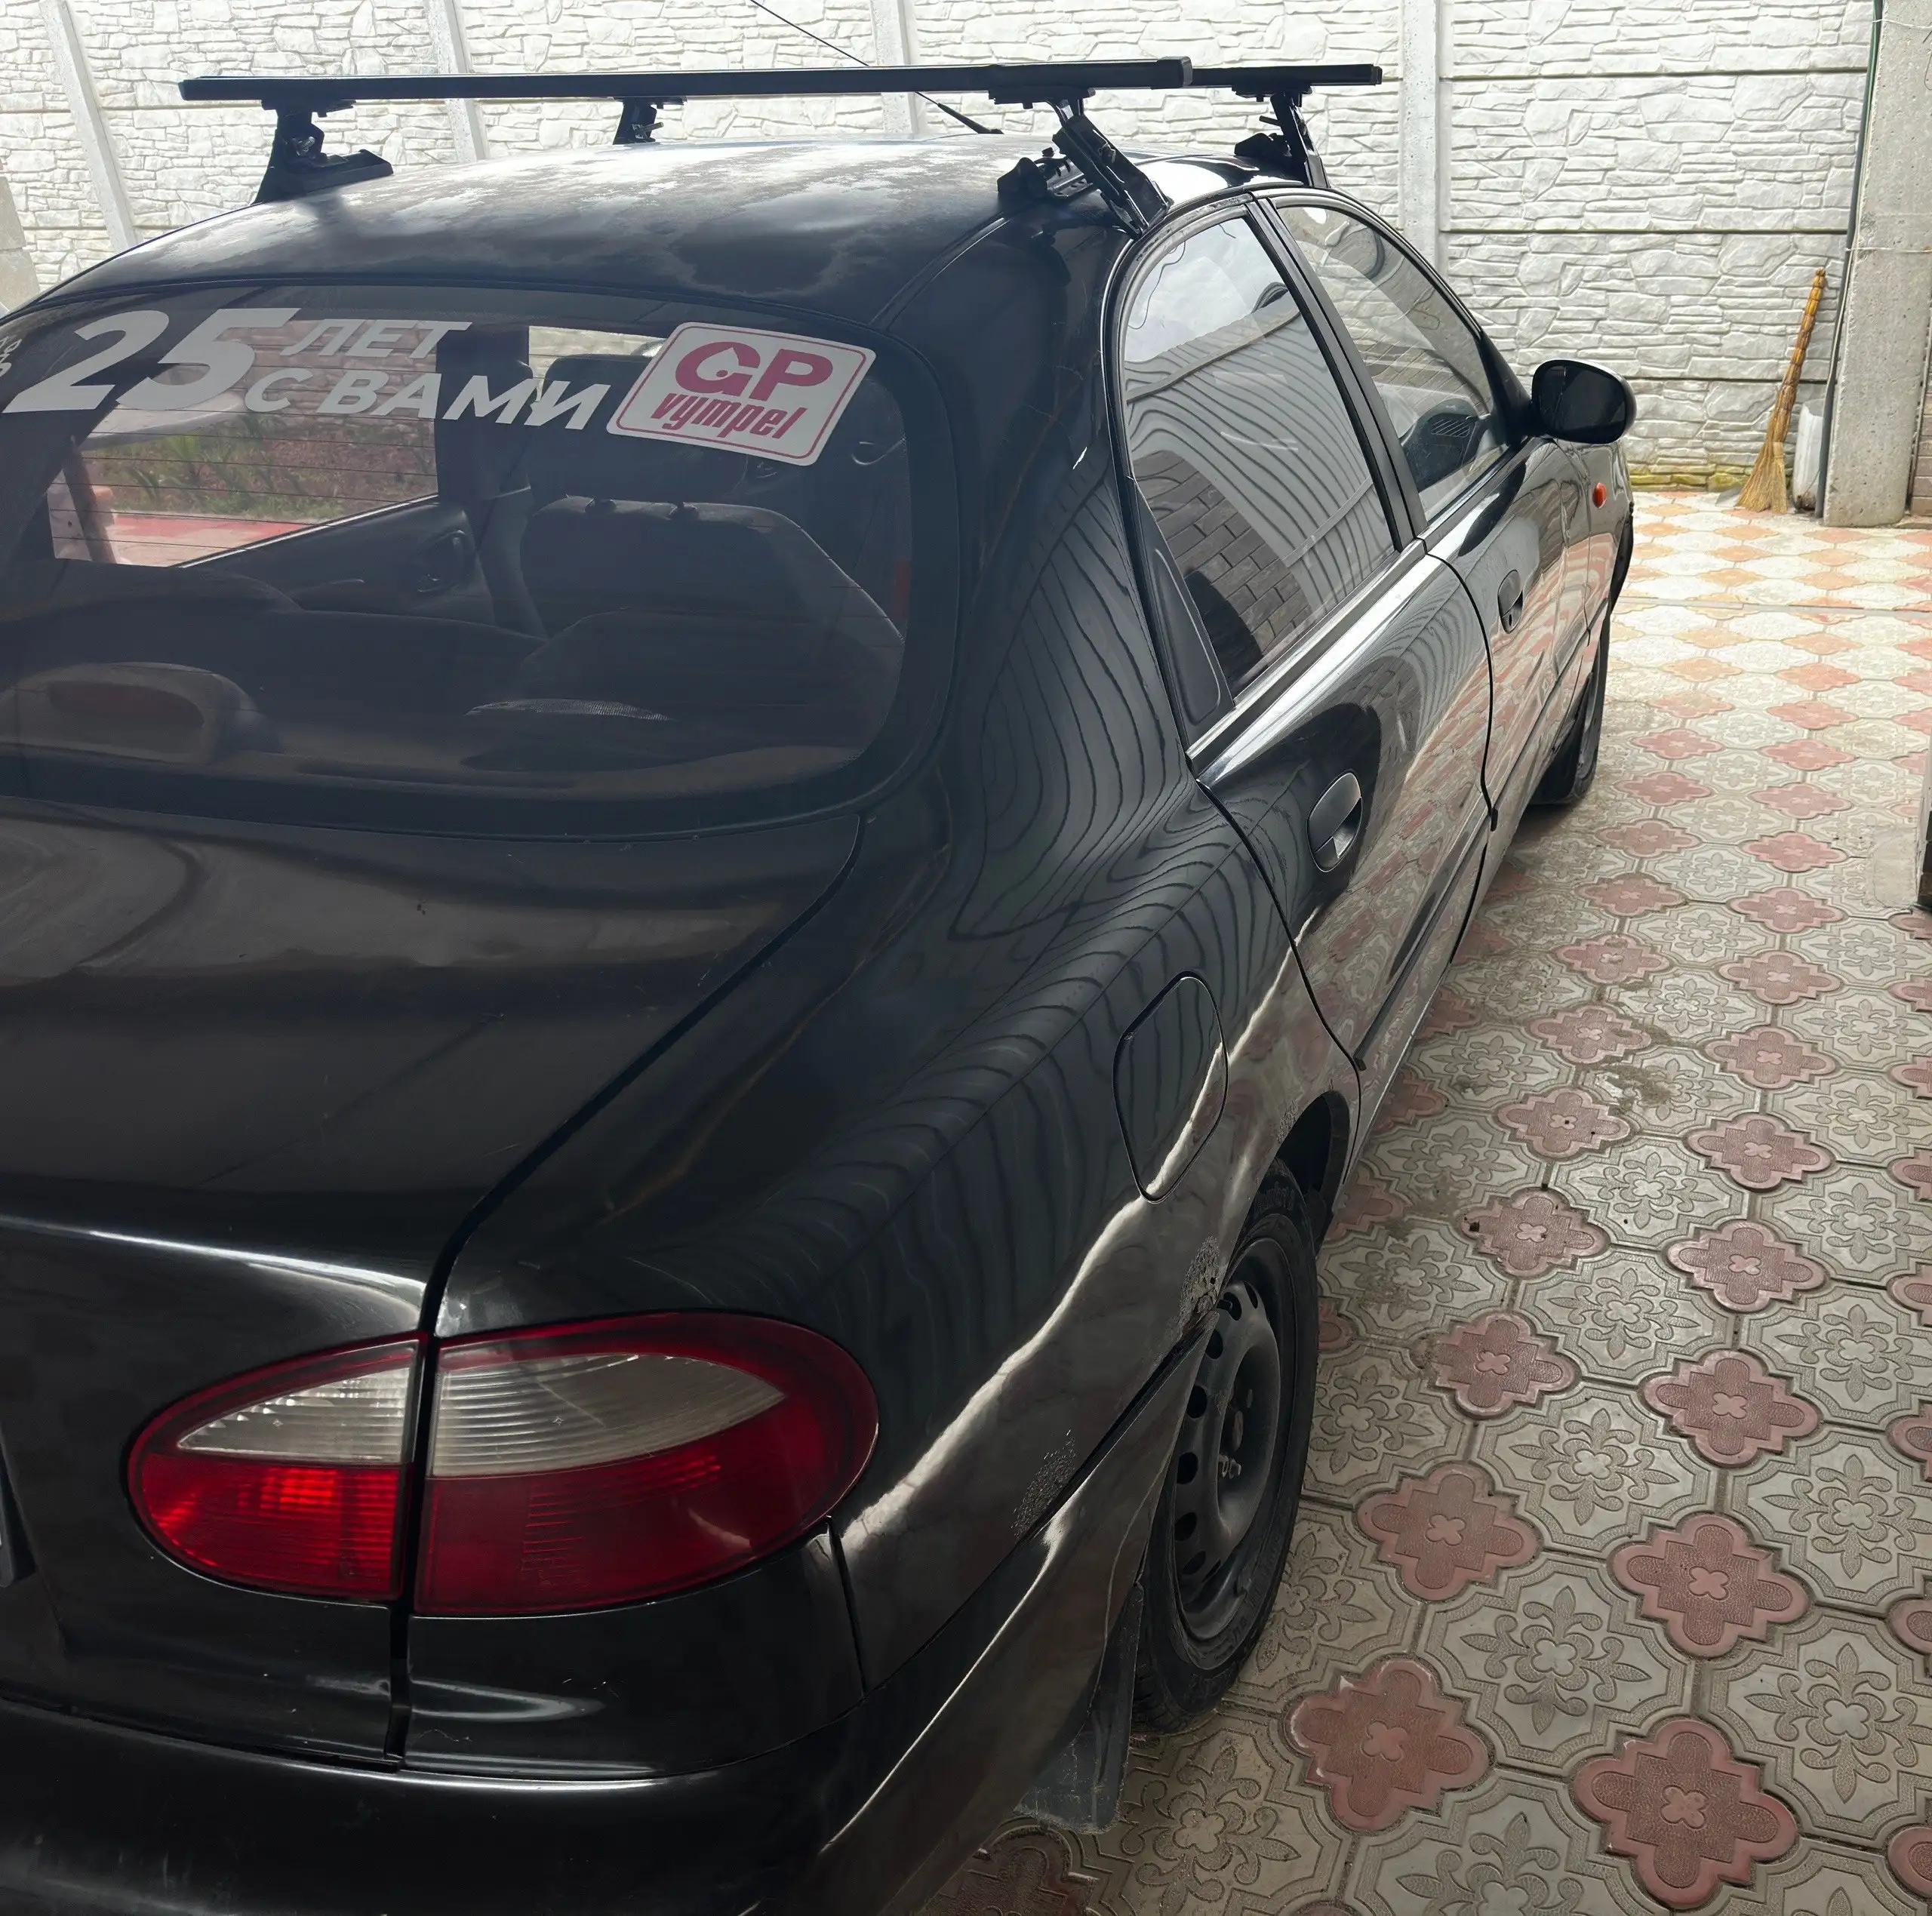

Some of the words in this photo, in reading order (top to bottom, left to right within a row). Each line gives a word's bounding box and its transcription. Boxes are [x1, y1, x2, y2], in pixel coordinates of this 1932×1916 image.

[2, 308, 301, 414] 25
[280, 318, 472, 358] ЛЕТ
[675, 341, 833, 401] GP
[245, 368, 313, 413] С
[316, 373, 611, 430] ВАМИ
